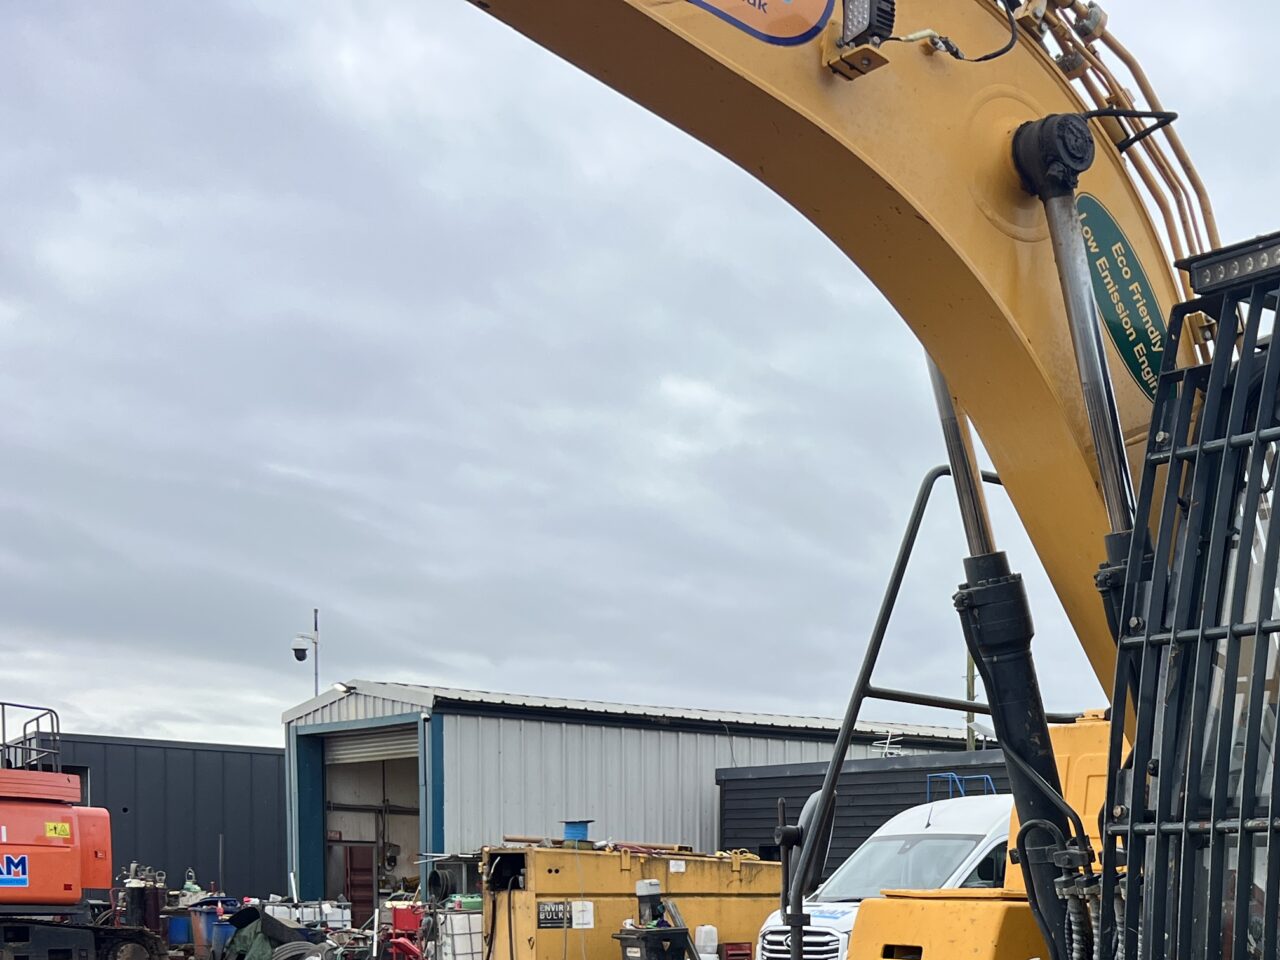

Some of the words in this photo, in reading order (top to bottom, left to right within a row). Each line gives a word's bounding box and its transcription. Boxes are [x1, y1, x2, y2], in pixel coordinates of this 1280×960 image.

[1096, 256, 1137, 342] Emission
[1133, 342, 1159, 395] Engin
[1111, 241, 1132, 280] Eco
[1128, 281, 1164, 352] Friendly
